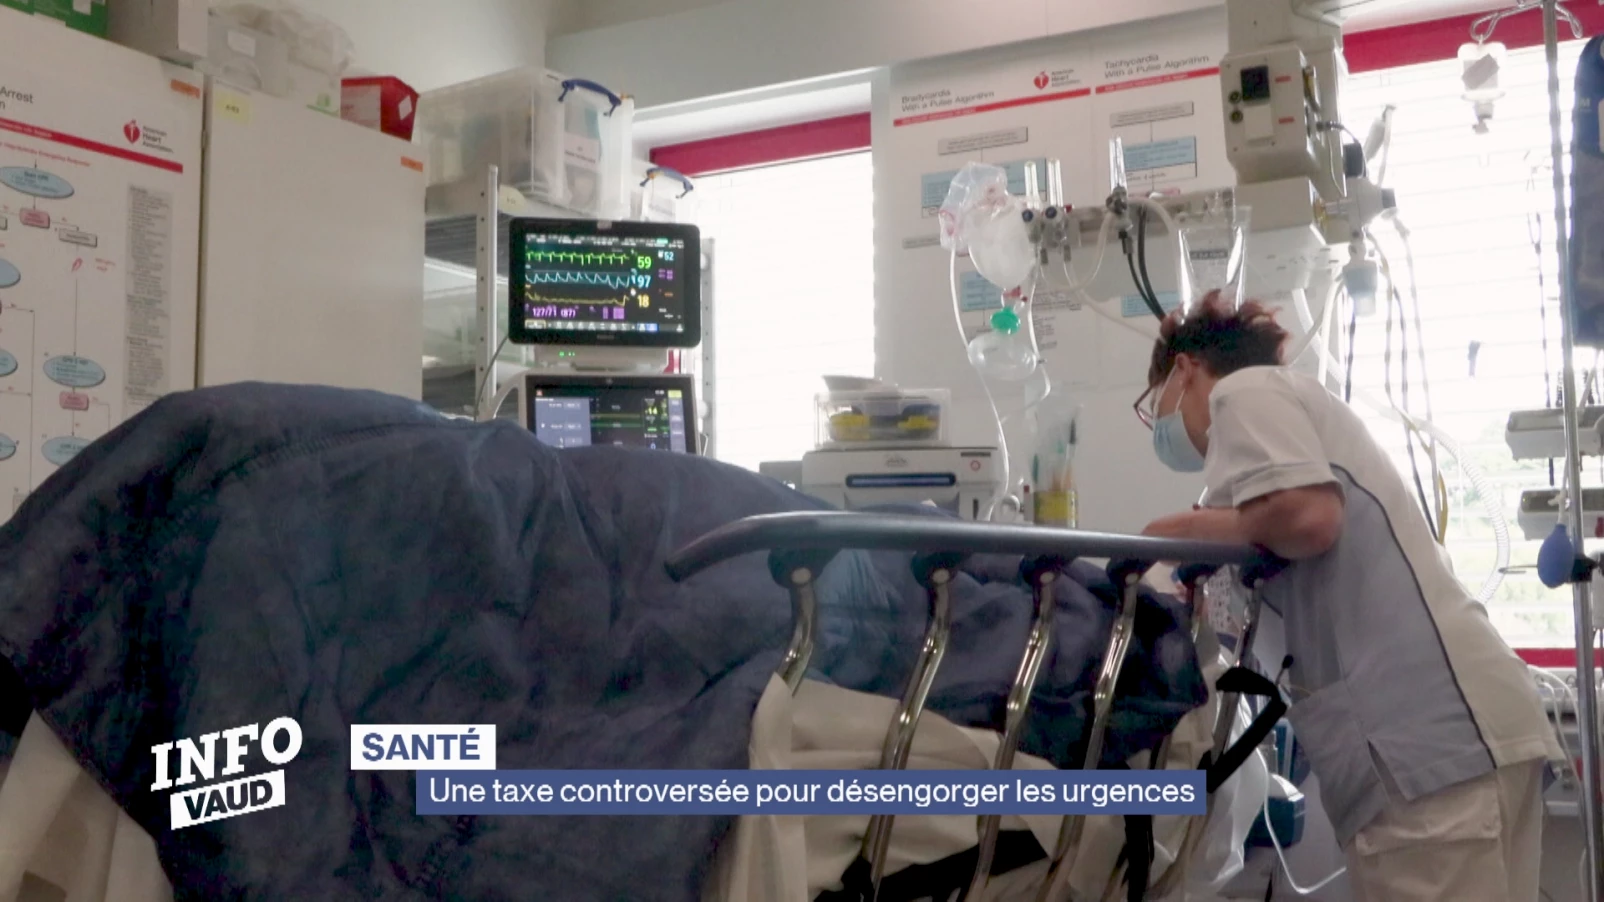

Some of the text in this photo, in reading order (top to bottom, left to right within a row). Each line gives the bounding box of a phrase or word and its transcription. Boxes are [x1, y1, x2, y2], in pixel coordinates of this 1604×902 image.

[1104, 54, 1159, 70] Tachycardia
[1104, 68, 1126, 79] With
[1136, 63, 1162, 74] Pulse
[1164, 54, 1210, 69] Algorithm
[0, 86, 34, 104] Arrest
[902, 88, 951, 105] Bradycardia
[902, 102, 920, 113] With
[929, 99, 953, 108] Pulse
[955, 91, 995, 105] Algorithm
[142, 132, 162, 145] Heart
[637, 256, 652, 269] 59
[637, 274, 652, 289] 97
[637, 294, 650, 308] 18
